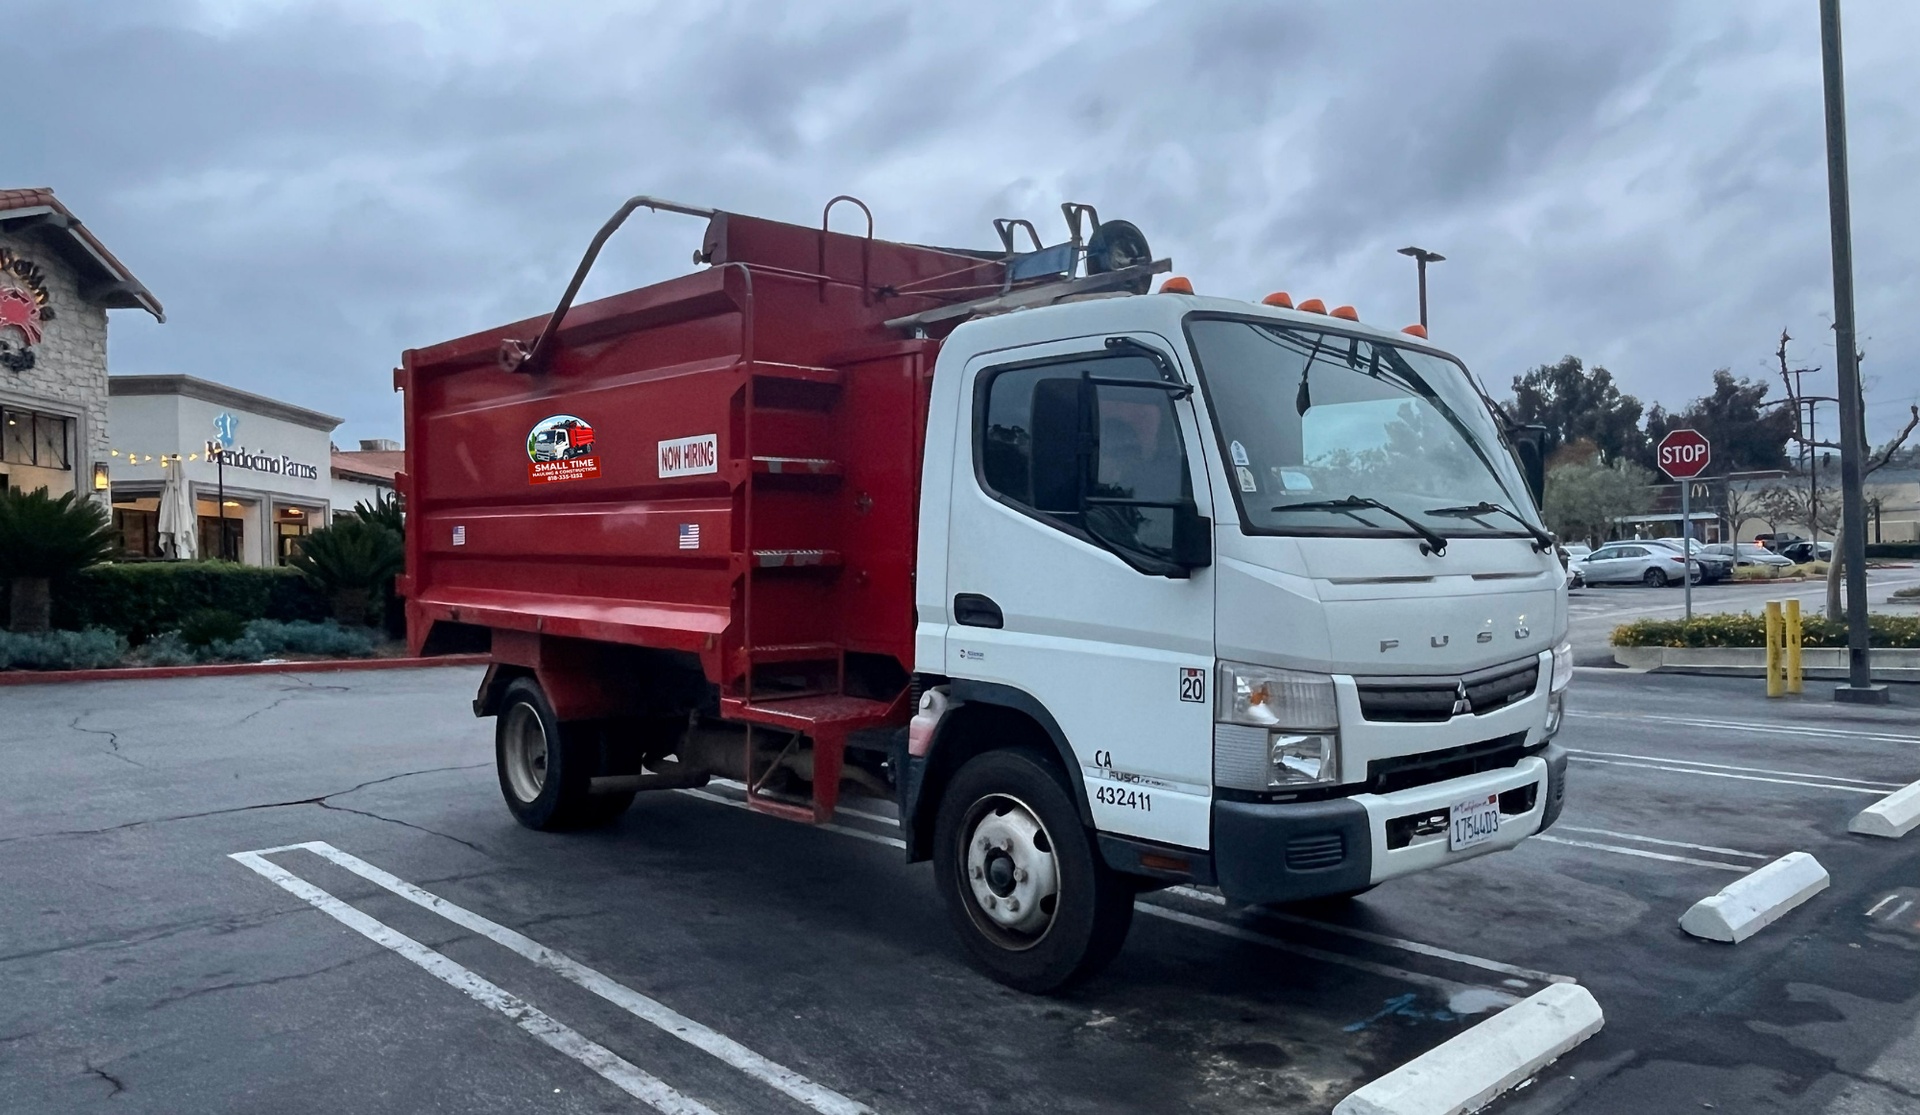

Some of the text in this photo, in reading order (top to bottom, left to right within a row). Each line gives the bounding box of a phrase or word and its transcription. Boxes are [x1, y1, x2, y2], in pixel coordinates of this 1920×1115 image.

[206, 441, 318, 480] Mendocino Farms
[534, 458, 594, 472] SMALL TIME
[661, 440, 714, 471] NOW HIRING
[1662, 444, 1706, 464] STOP
[560, 466, 597, 475] CONSTRUCTION
[1380, 626, 1530, 653] FUSO
[1182, 677, 1202, 700] 20
[1095, 750, 1112, 769] CA
[1109, 770, 1140, 785] FUSO
[1096, 786, 1151, 812] 432411
[1455, 810, 1499, 843] 17544D3
